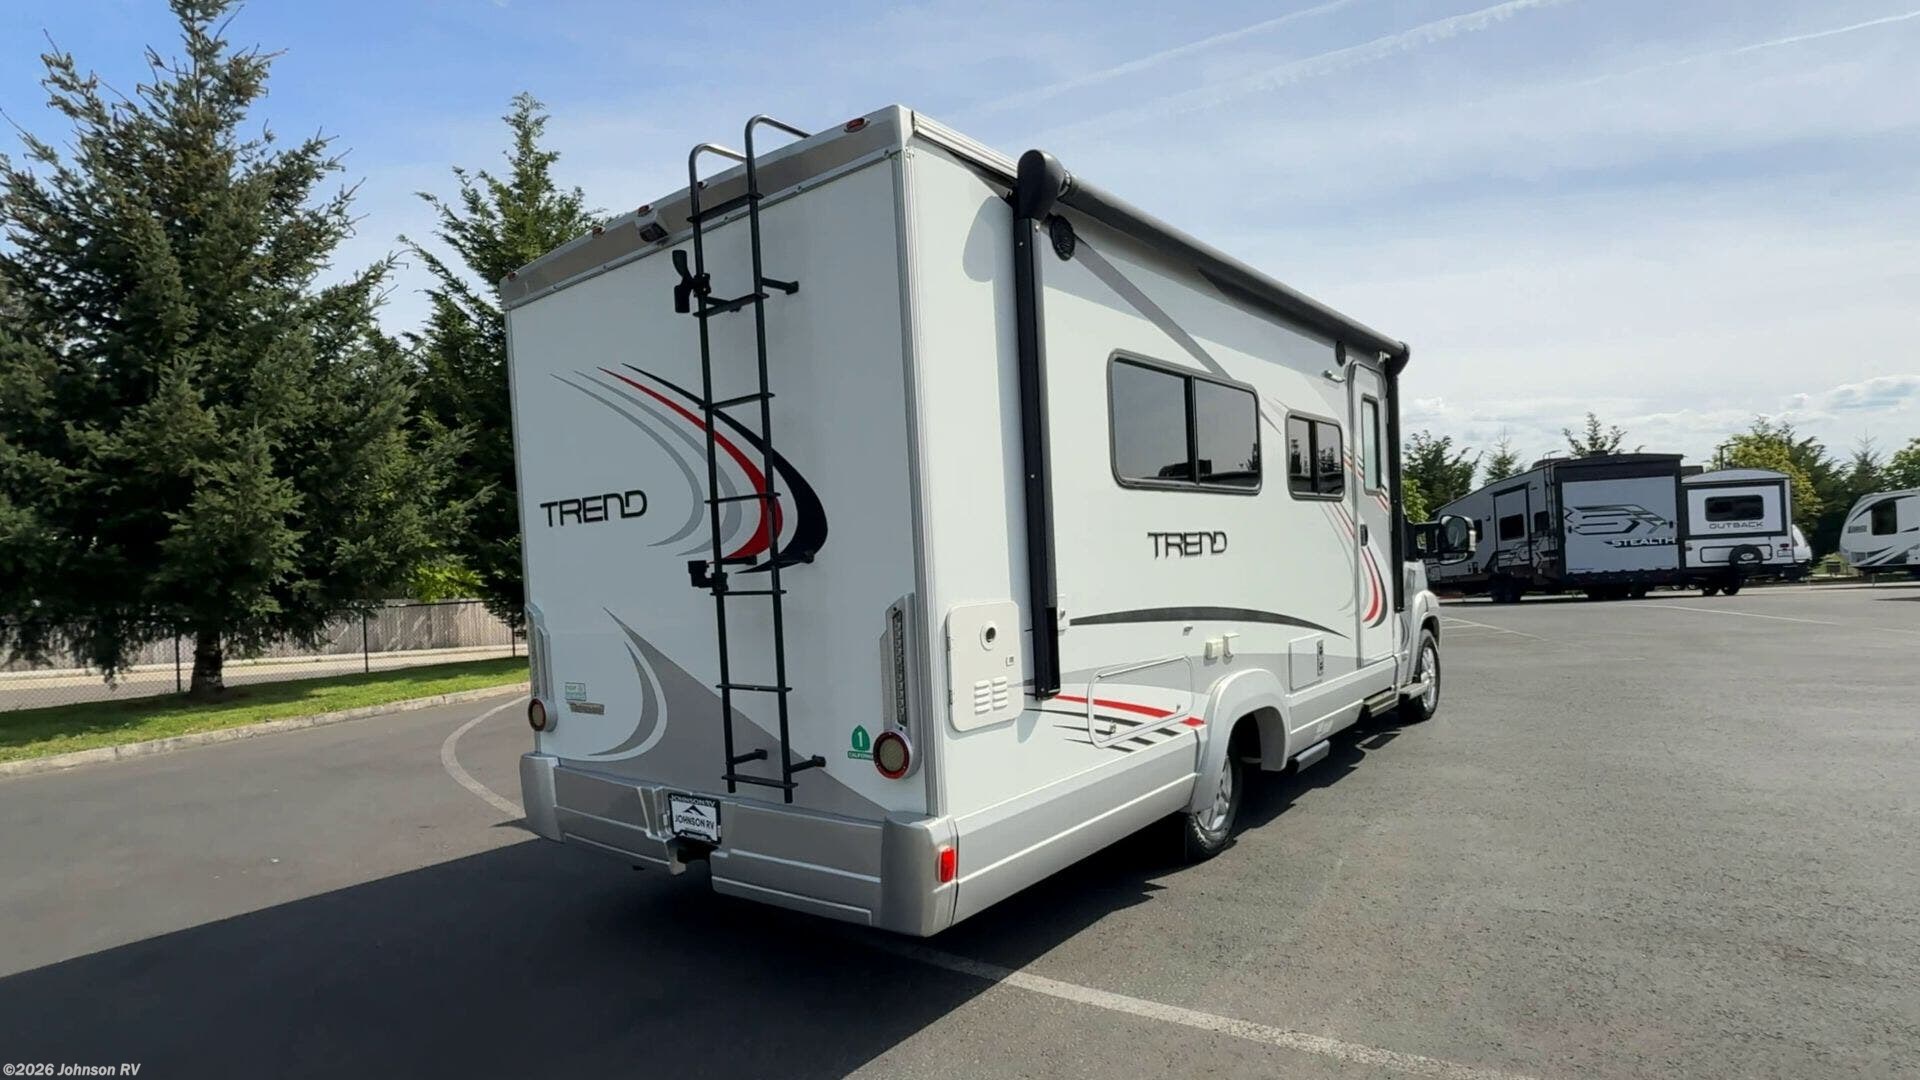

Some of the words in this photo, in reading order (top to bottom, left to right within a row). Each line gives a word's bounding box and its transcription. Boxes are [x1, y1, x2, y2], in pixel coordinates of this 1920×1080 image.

[540, 490, 647, 528] TREND
[1709, 521, 1764, 530] OUTBACK
[1147, 531, 1227, 559] TREND
[1611, 537, 1677, 547] STEALTH
[857, 731, 863, 748] 1
[675, 814, 706, 828] JOHNSON
[706, 820, 715, 830] RV
